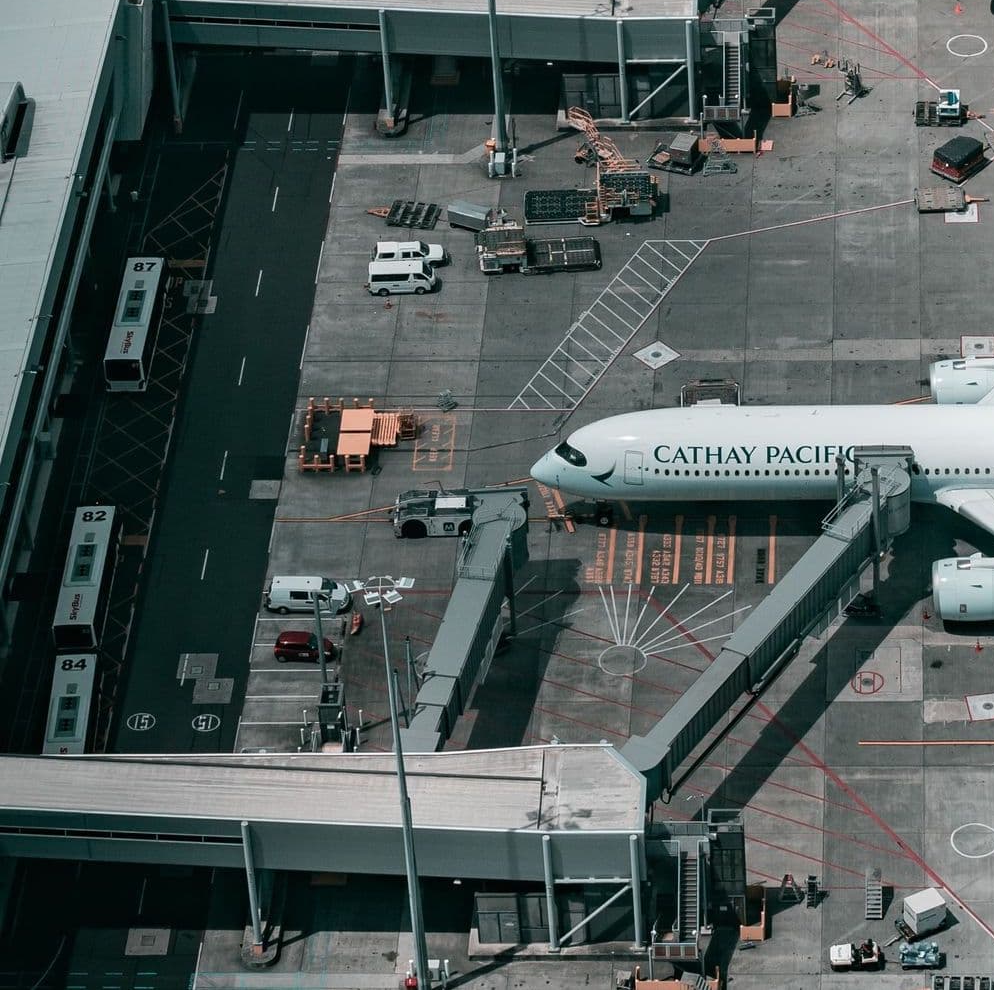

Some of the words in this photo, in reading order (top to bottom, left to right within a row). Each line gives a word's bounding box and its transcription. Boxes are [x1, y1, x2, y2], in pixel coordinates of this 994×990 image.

[133, 262, 157, 272] 87
[654, 445, 756, 464] CATHAY
[81, 511, 107, 523] 82
[69, 593, 80, 620] SkyBus
[60, 659, 87, 671] 84
